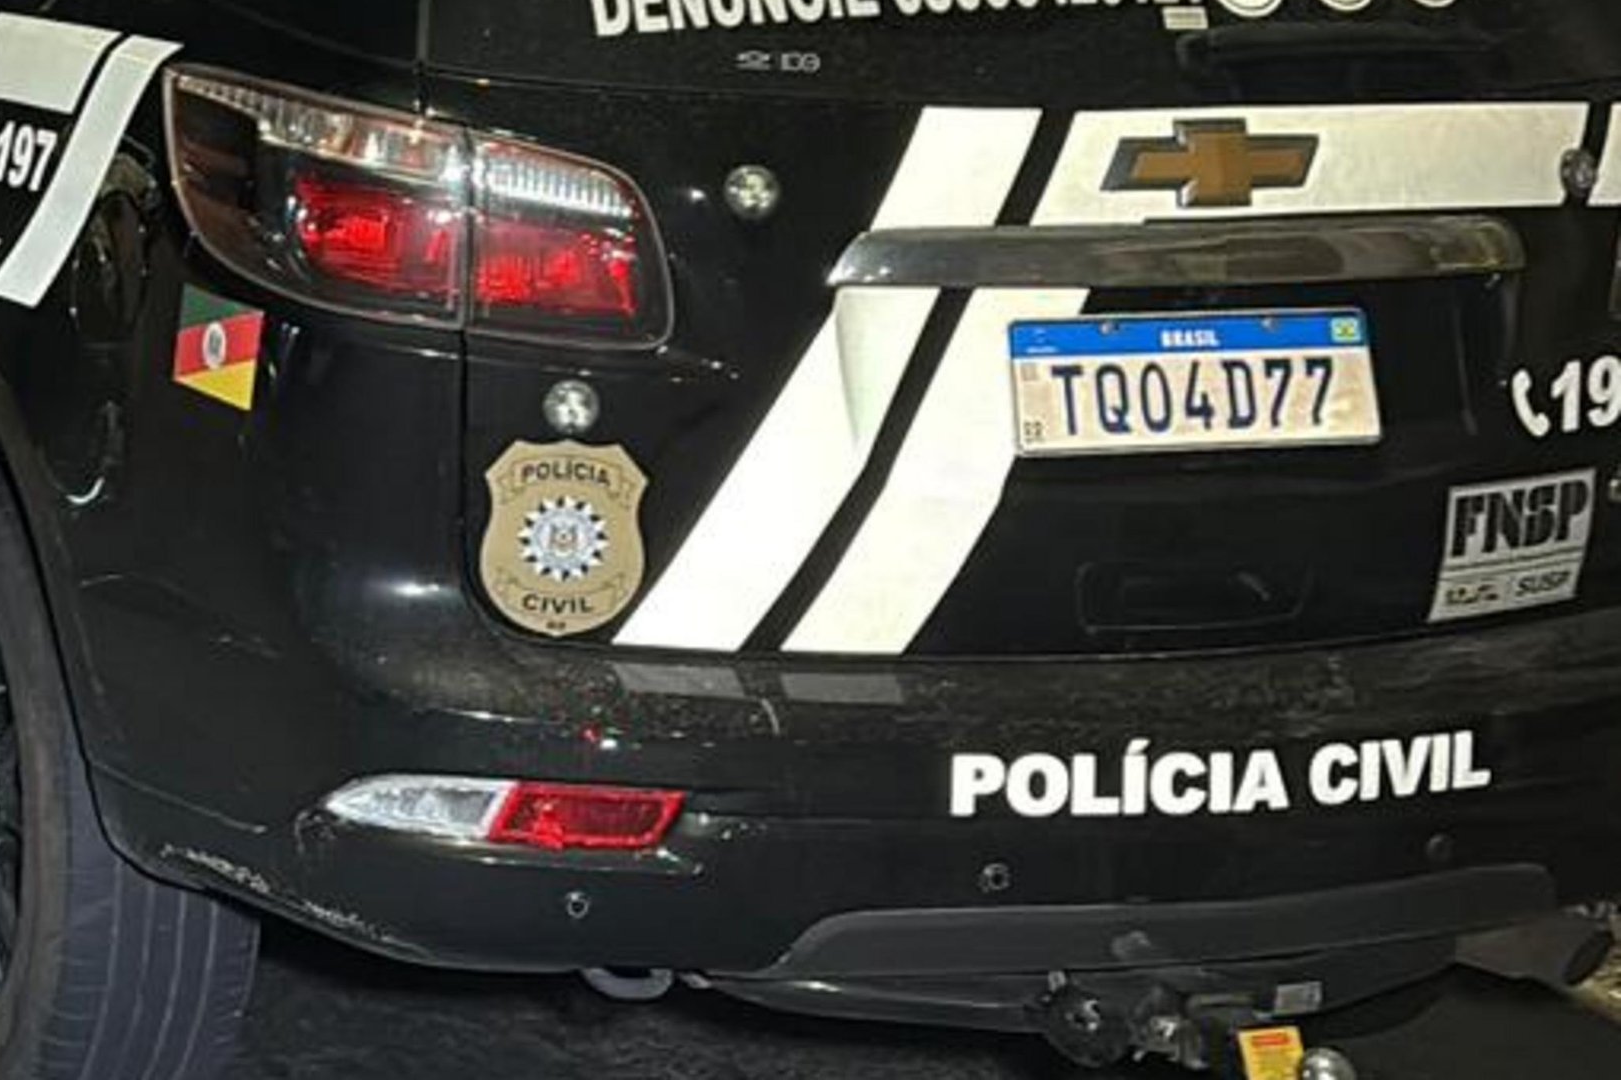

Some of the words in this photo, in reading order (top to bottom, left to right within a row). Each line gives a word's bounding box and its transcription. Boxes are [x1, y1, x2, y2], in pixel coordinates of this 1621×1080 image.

[1160, 328, 1220, 348] BRASIL
[521, 458, 611, 487] POLÍCIA
[521, 591, 594, 614] CIVIL
[950, 738, 1290, 817] POLÍCIA
[1308, 730, 1492, 805] CIVIL
